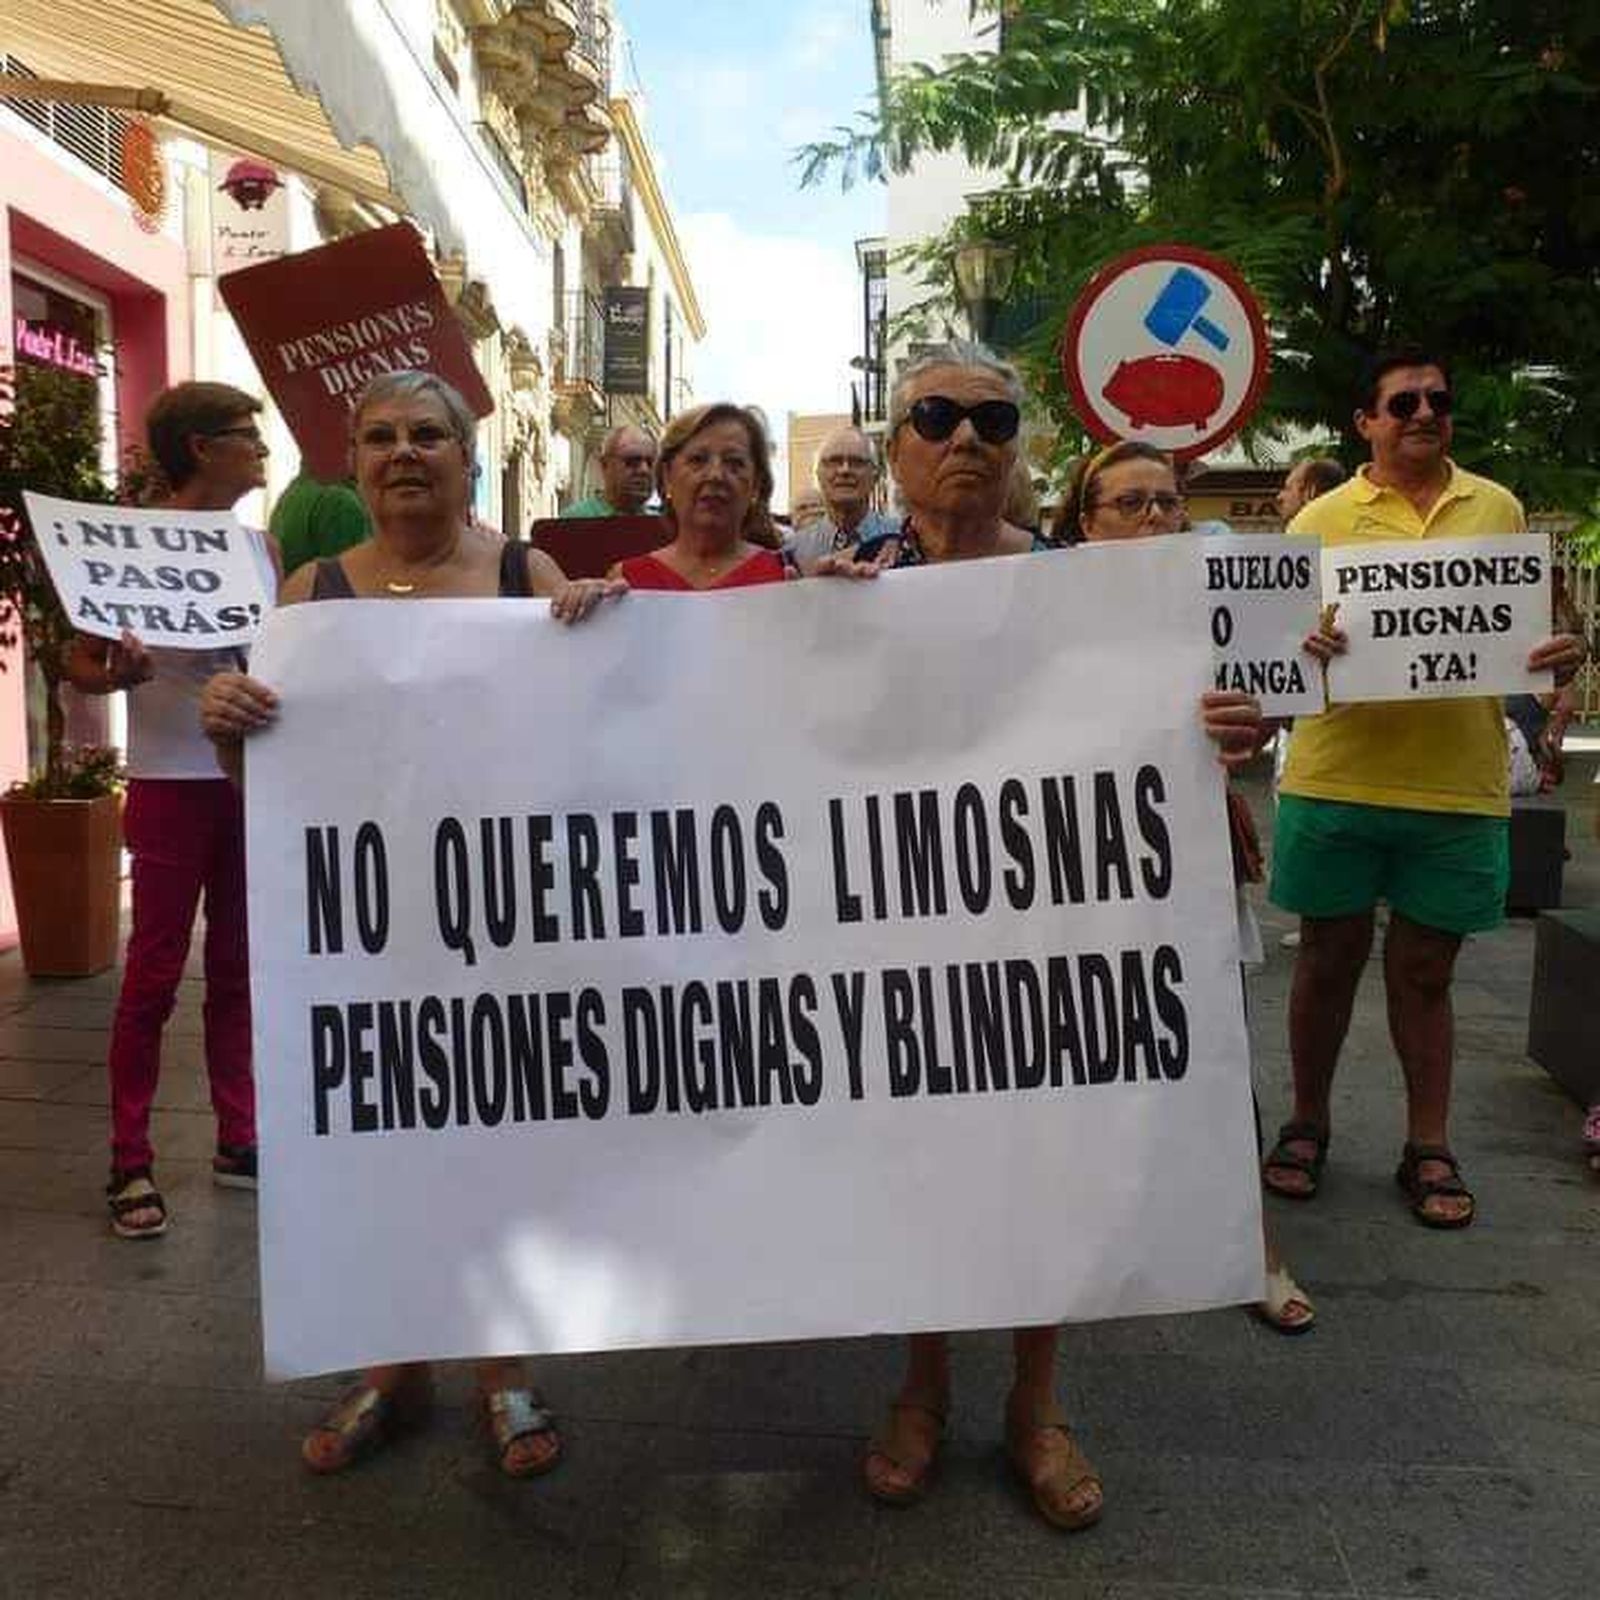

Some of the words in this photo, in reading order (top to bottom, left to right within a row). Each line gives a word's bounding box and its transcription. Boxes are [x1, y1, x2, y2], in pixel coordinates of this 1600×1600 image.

[278, 301, 434, 372] PENSIONES
[320, 336, 431, 396] DIGNAS
[149, 526, 230, 554] UN
[83, 558, 222, 594] PASO
[1205, 555, 1311, 591] BUELOS
[1334, 555, 1542, 595] PENSIONES
[77, 595, 262, 635] ATRÁS!
[1371, 603, 1513, 639] DIGNAS
[1409, 652, 1478, 691] ¡YA!
[306, 821, 390, 955] NO
[434, 801, 789, 966] QUEREMOS
[829, 764, 1173, 924] LIMOSNAS
[310, 986, 611, 1136] PENSIONES
[621, 973, 823, 1116] DIGNAS
[831, 971, 865, 1101] Y
[881, 944, 1190, 1098] BLINDADAS
